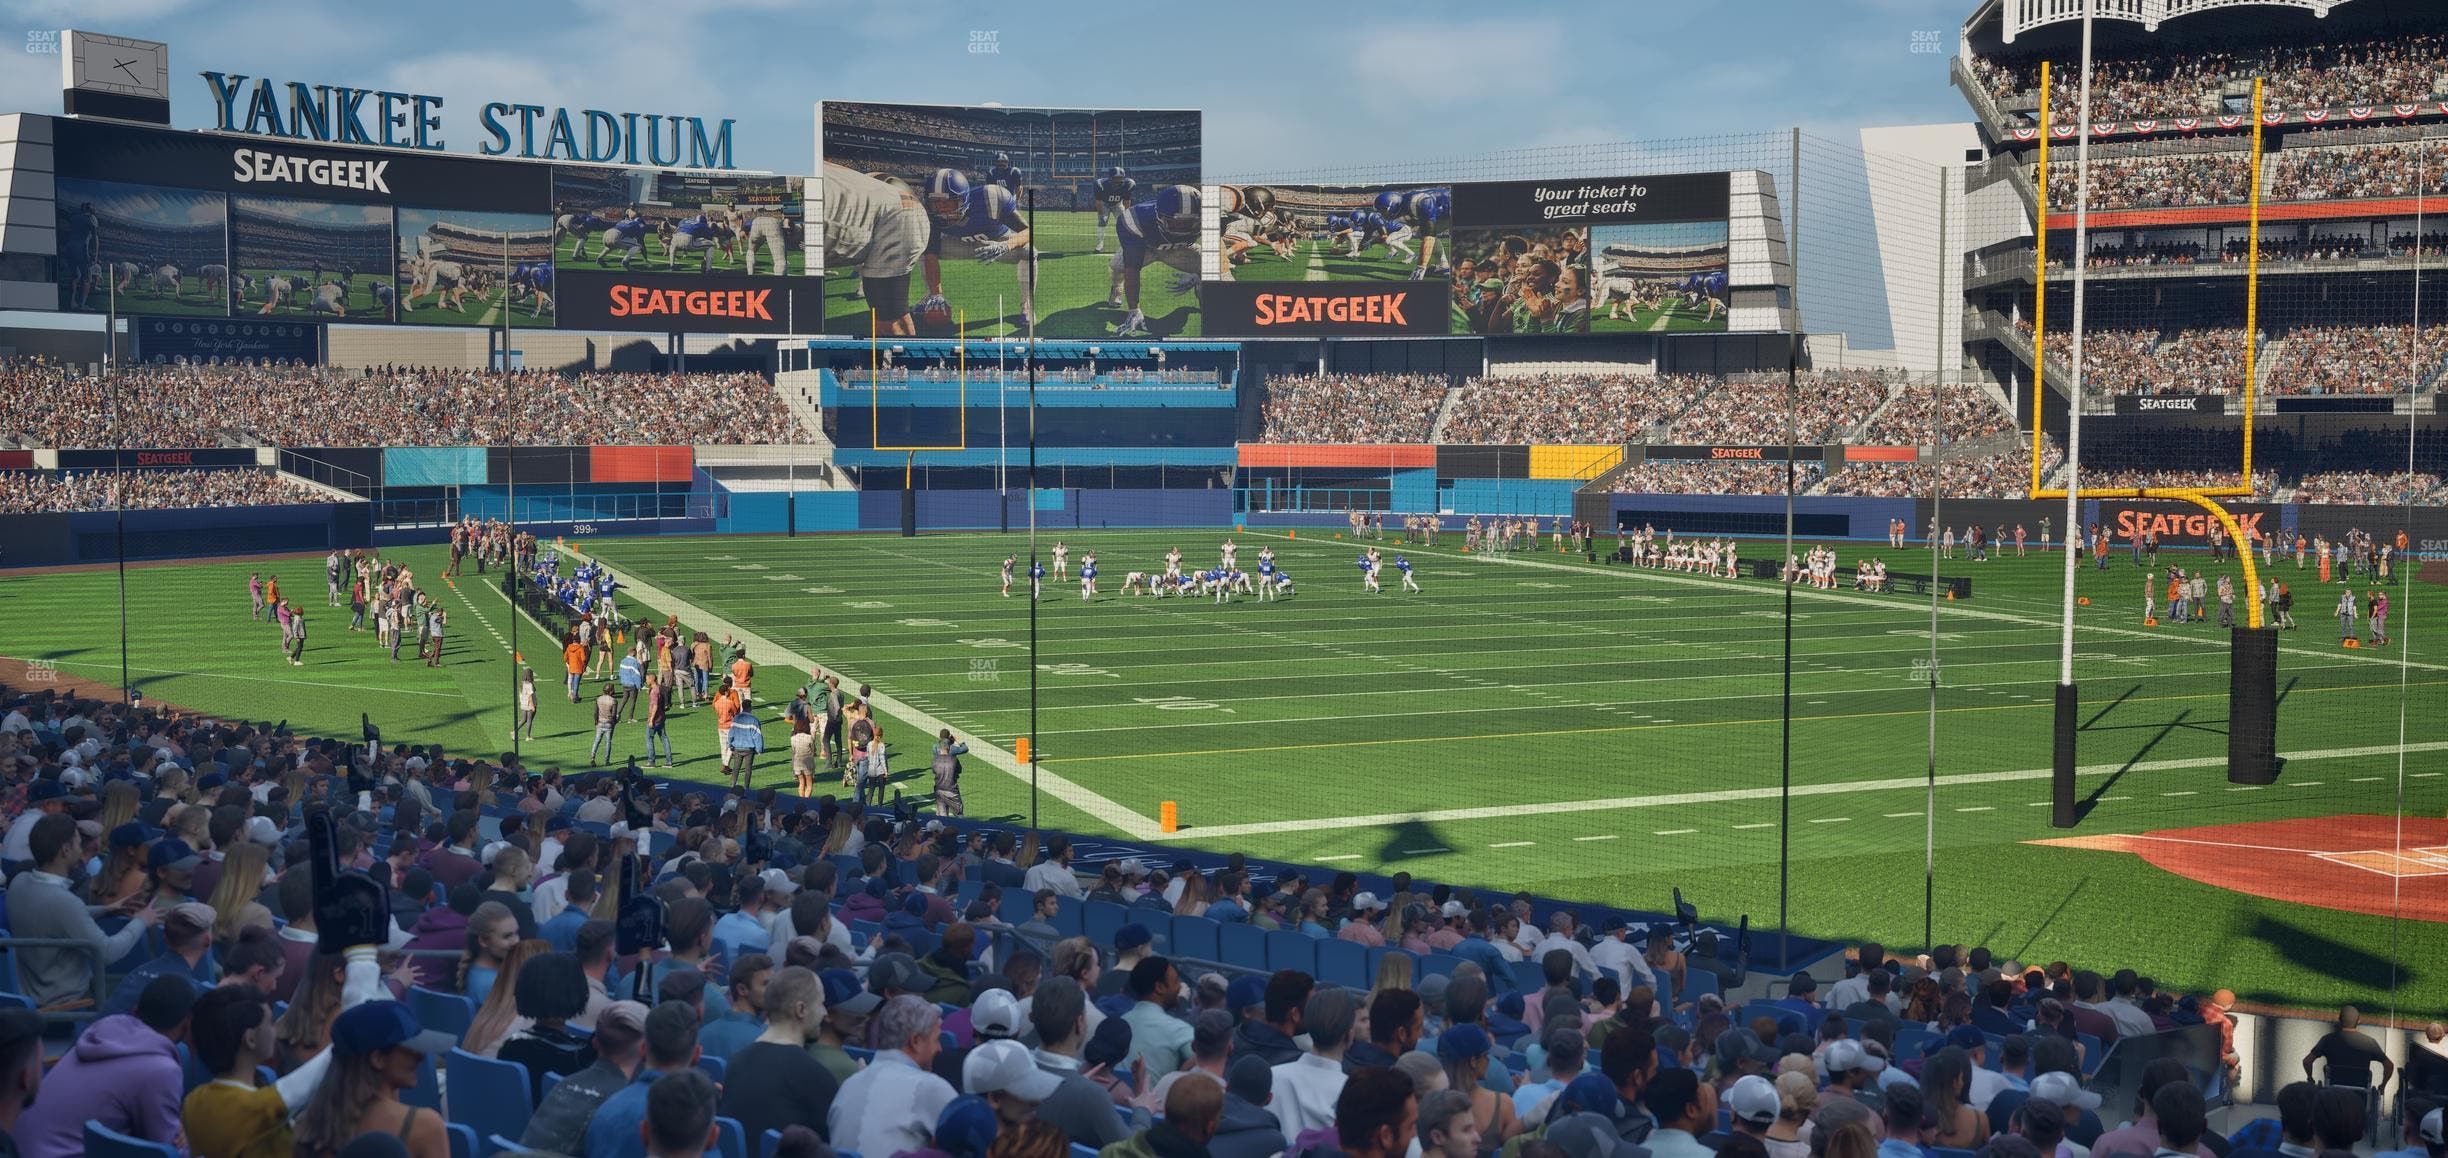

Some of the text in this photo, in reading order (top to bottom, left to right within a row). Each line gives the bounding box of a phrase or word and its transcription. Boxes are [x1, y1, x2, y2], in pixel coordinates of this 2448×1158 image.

[198, 71, 737, 170] YANKEE STADIUM
[234, 148, 391, 194] SEATGEEK
[1534, 184, 1647, 202] Your ticket to
[1543, 200, 1637, 219] great seats
[610, 284, 773, 321] SEATGEEK
[1255, 292, 1408, 326] SEATGEEK
[2139, 398, 2197, 410] SEATGEEK
[137, 452, 193, 465] SEATGEEK
[1711, 447, 1762, 459] SEATGEEK
[2117, 510, 2264, 541] SEATGEK
